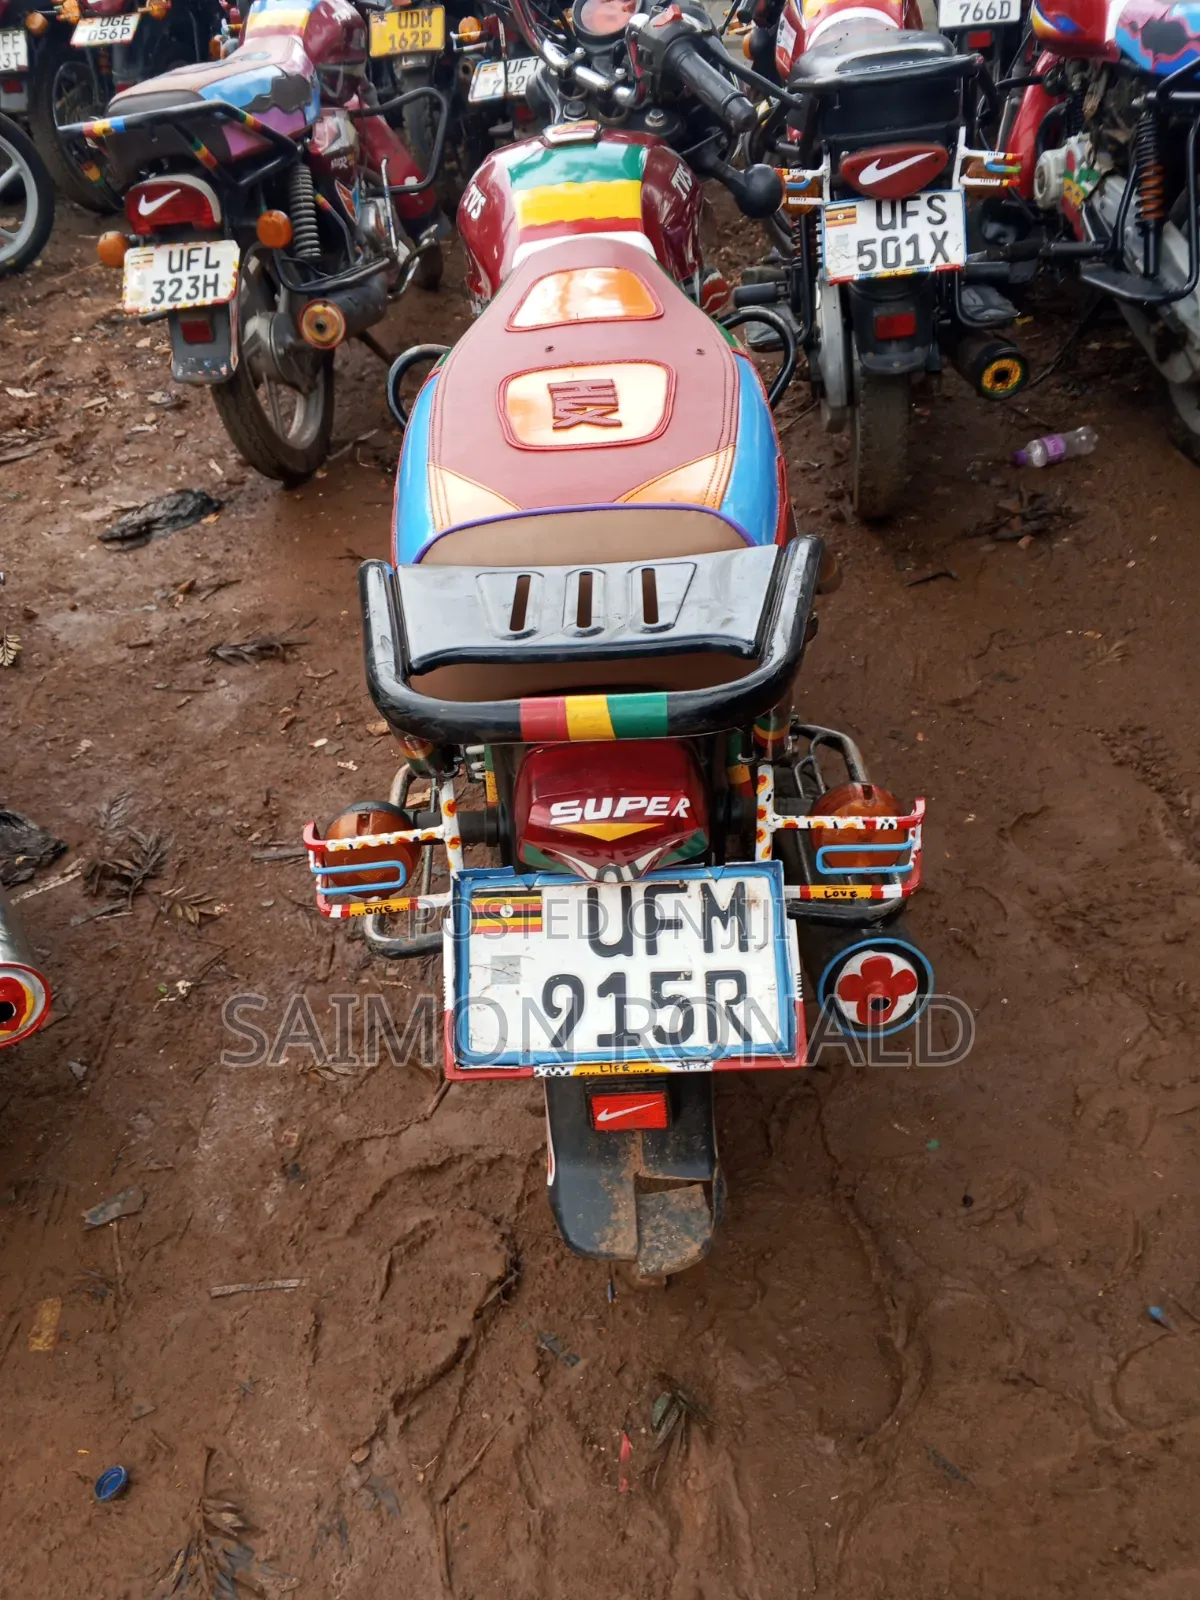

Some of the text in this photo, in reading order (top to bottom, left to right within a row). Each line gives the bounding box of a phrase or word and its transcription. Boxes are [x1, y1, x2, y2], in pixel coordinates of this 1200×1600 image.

[397, 9, 433, 29] UDM
[959, 0, 1011, 23] 766D
[0, 33, 20, 50] FF
[388, 30, 432, 51] 162P
[671, 163, 693, 201] TVS
[463, 183, 487, 220] TVS
[875, 194, 947, 231] UFS
[168, 246, 220, 274] UFL
[857, 230, 950, 272] 501X
[150, 273, 219, 305] 323H
[550, 796, 691, 825] SUPER
[824, 889, 858, 899] LOVE
[586, 880, 749, 958] UFM
[541, 969, 753, 1051] 915R
[600, 1063, 630, 1073] LIFE
